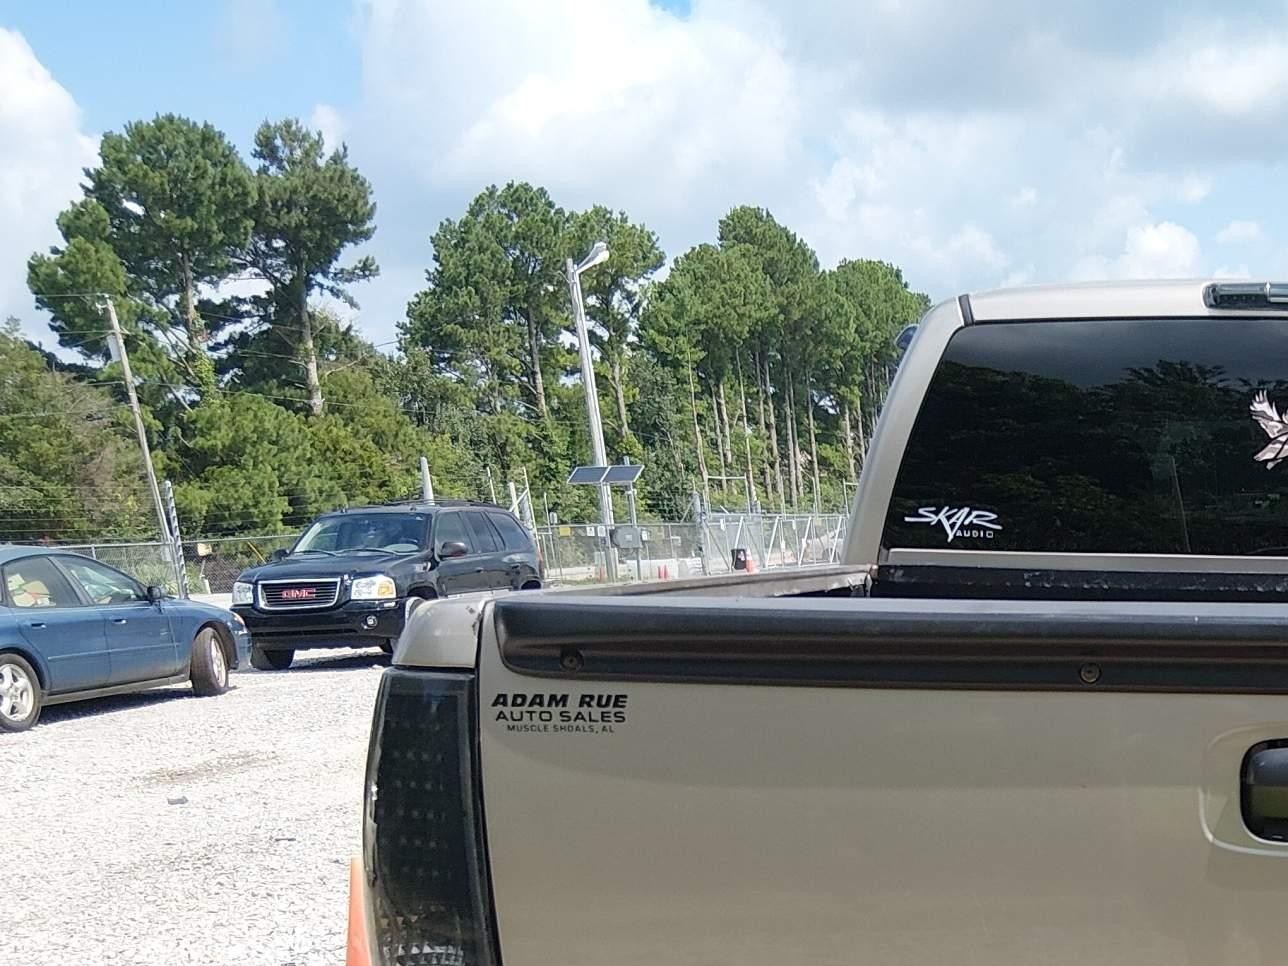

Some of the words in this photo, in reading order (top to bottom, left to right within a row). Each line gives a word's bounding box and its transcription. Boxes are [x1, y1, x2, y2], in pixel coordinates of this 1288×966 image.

[904, 506, 1003, 543] SKAR
[955, 530, 994, 538] AUDIO
[281, 587, 316, 598] GMC
[491, 693, 569, 708] ADAM
[578, 694, 628, 708] RUE
[495, 710, 553, 722] AUTO
[559, 711, 626, 723] SALES
[507, 724, 549, 733] MUSCLE
[553, 725, 599, 734] SHOALS,
[601, 725, 615, 734] AL
